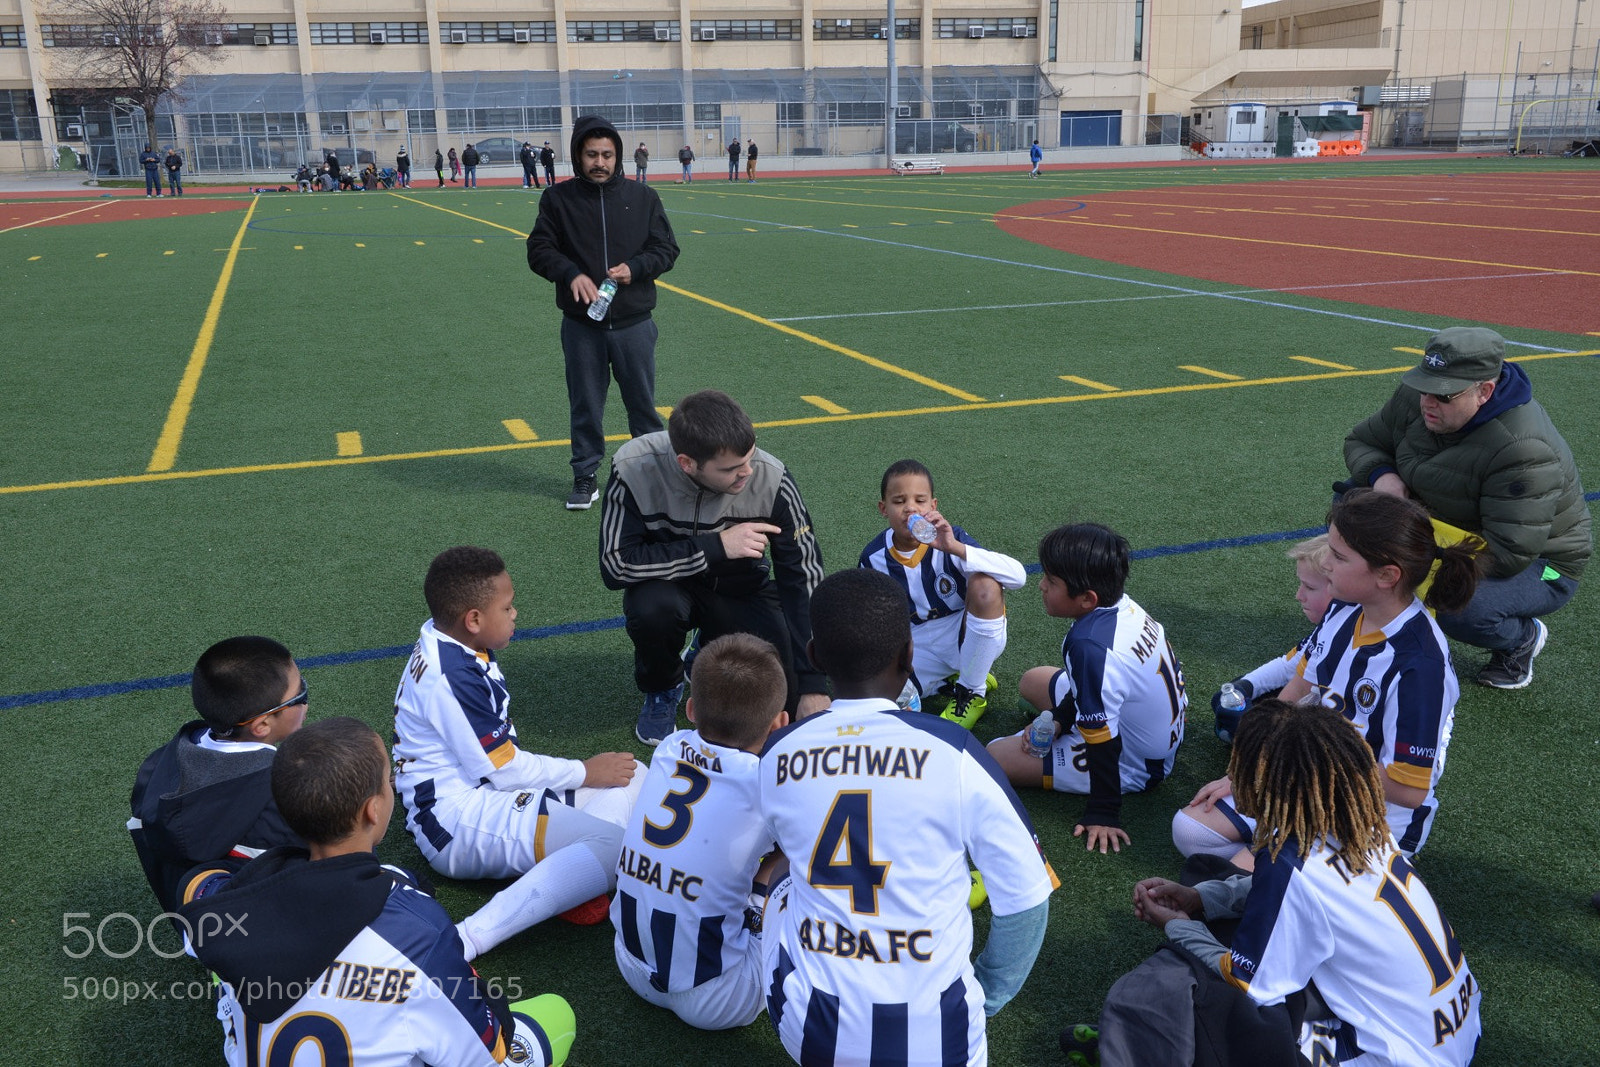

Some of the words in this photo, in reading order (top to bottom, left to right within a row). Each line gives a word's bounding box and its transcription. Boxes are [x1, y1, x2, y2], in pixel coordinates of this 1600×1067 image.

[680, 740, 723, 774] TOMA
[776, 744, 932, 787] BOTCHWAY
[642, 759, 711, 849] 3
[618, 845, 664, 894] ALBA
[665, 867, 704, 902] FC
[808, 789, 893, 917] 4
[799, 917, 885, 964] ALBA
[884, 928, 933, 964] FC
[320, 959, 416, 1005] TIBEBE
